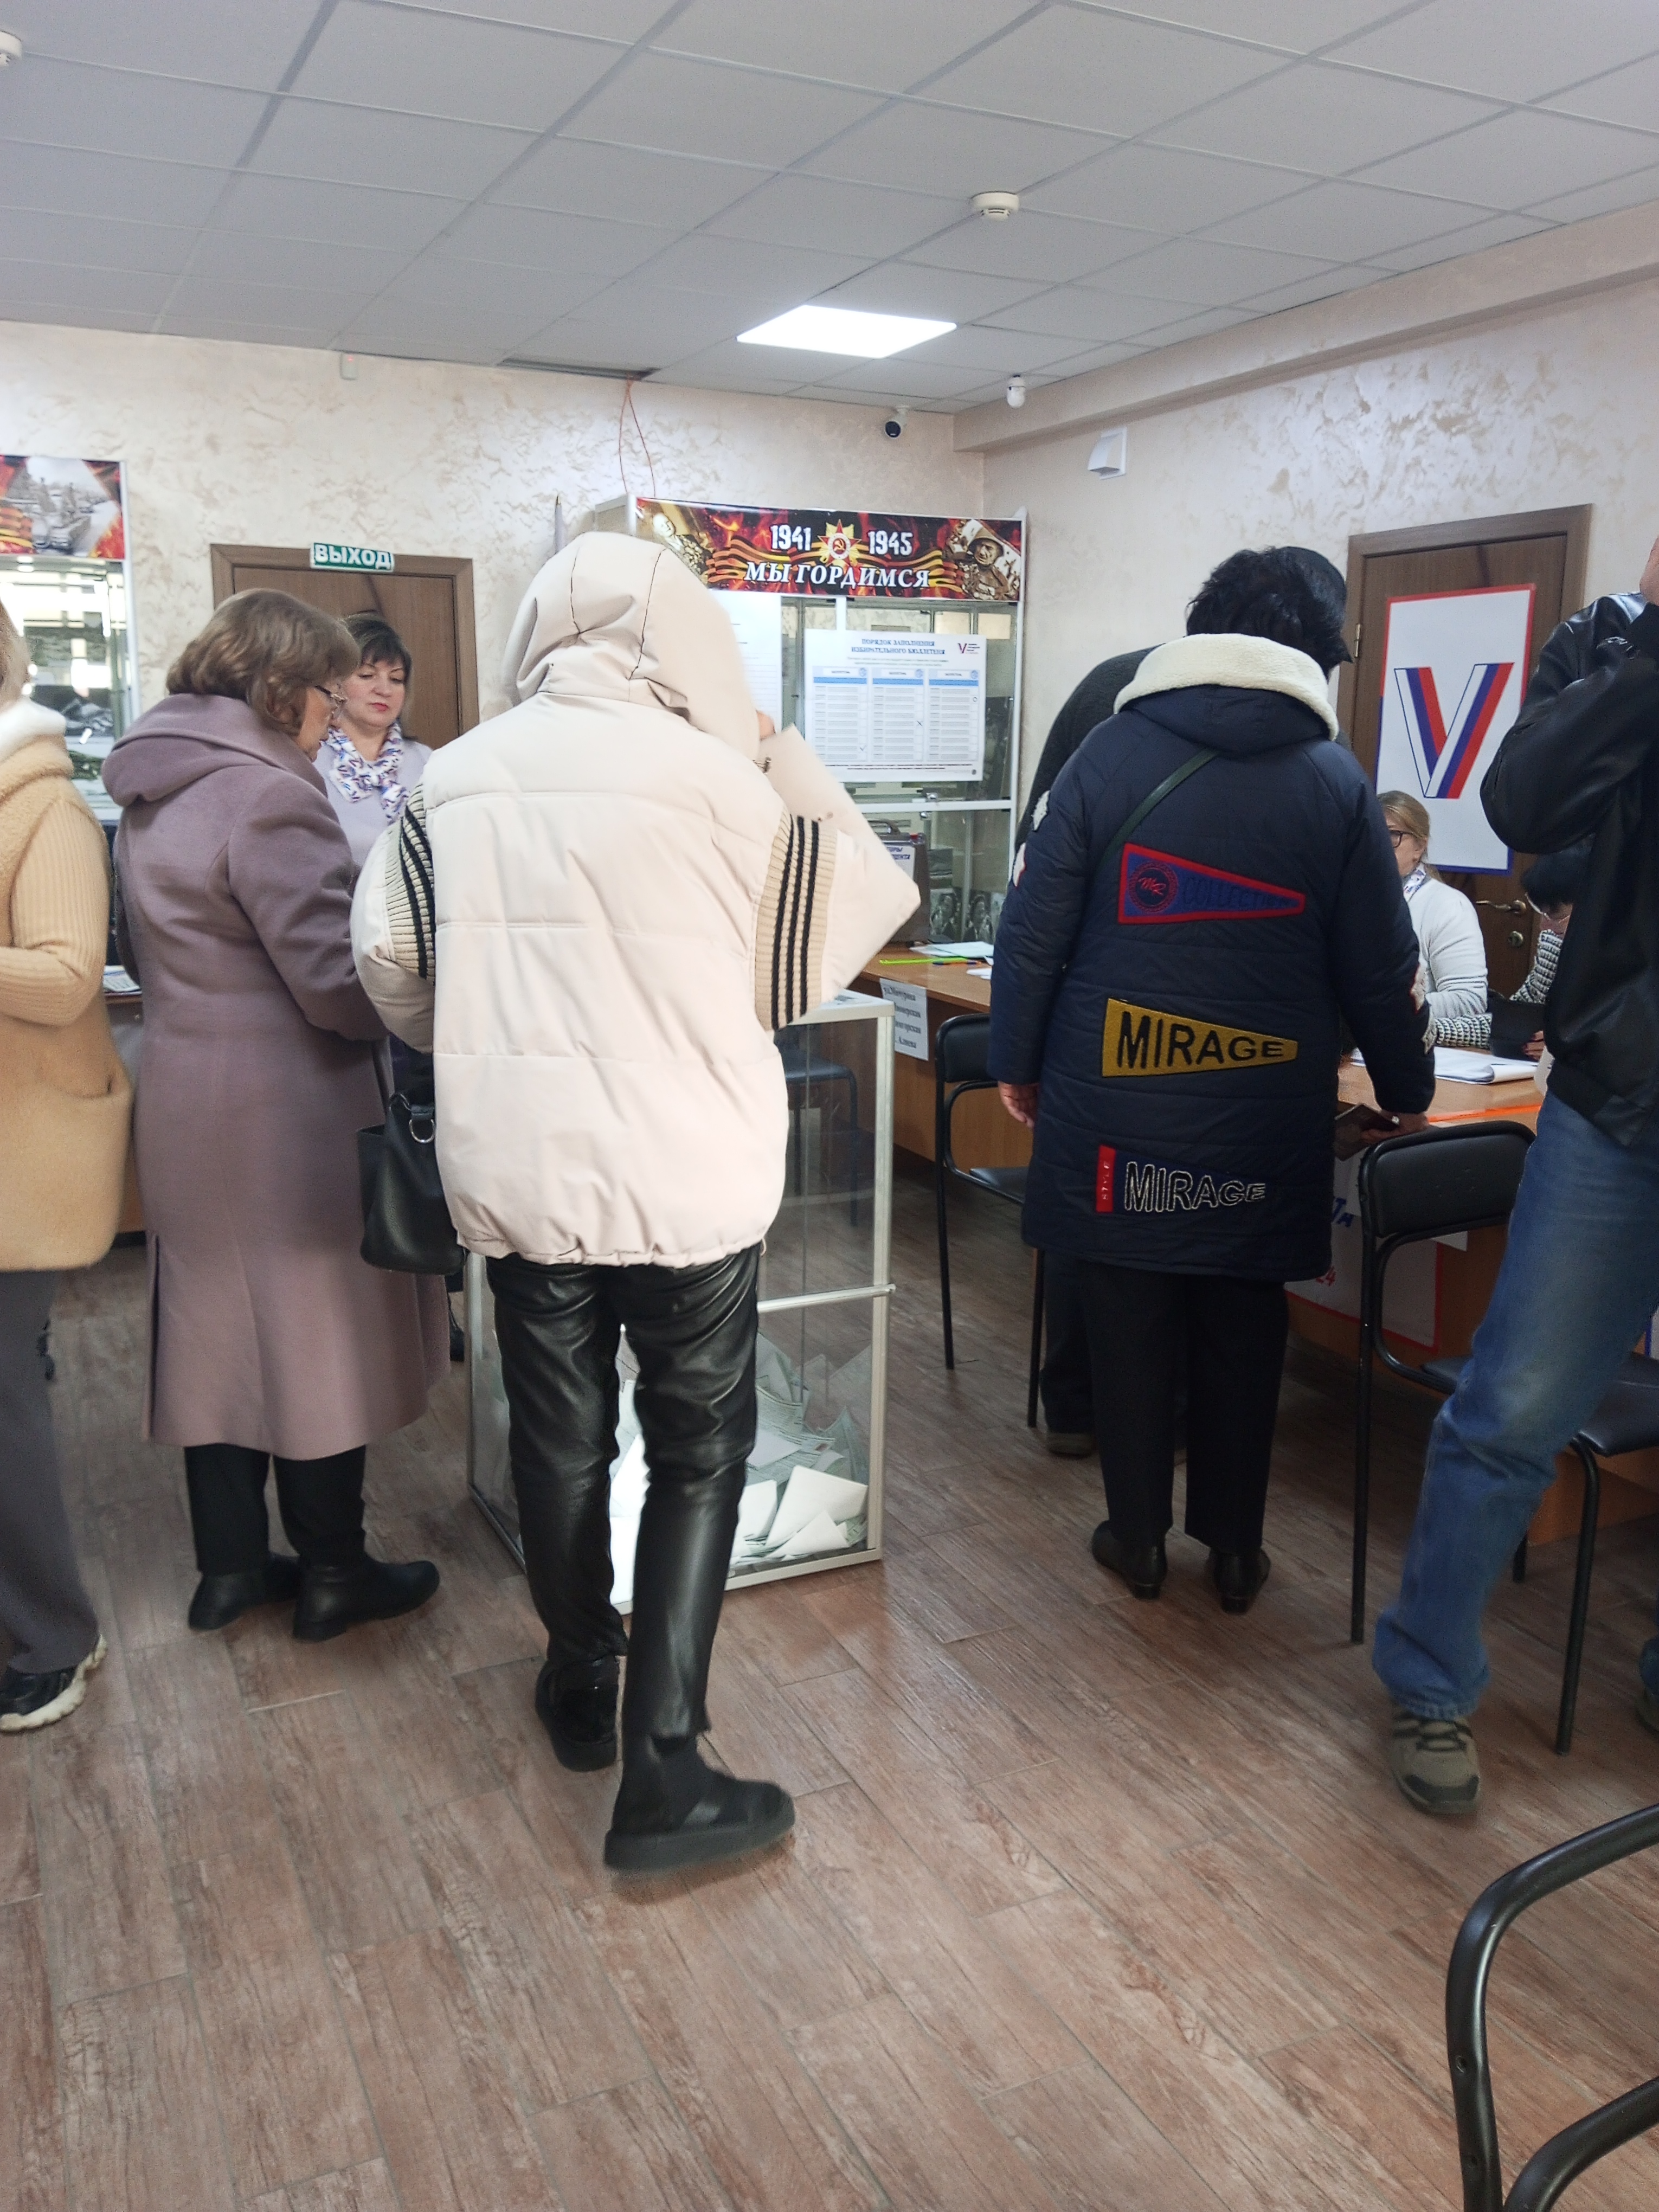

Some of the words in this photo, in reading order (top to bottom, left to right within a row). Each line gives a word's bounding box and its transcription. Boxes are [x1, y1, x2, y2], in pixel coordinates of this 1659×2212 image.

[314, 544, 391, 569] ВЫХОД
[770, 524, 812, 551] 1941
[868, 530, 914, 556] 1945
[744, 561, 792, 583] МЫ
[797, 564, 930, 589] ГОРДИМСЯ
[1393, 662, 1515, 799] V
[1117, 1011, 1284, 1069] MIRAGE
[1101, 1161, 1110, 1200] STYLE
[1124, 1161, 1266, 1212] MIRAGE
